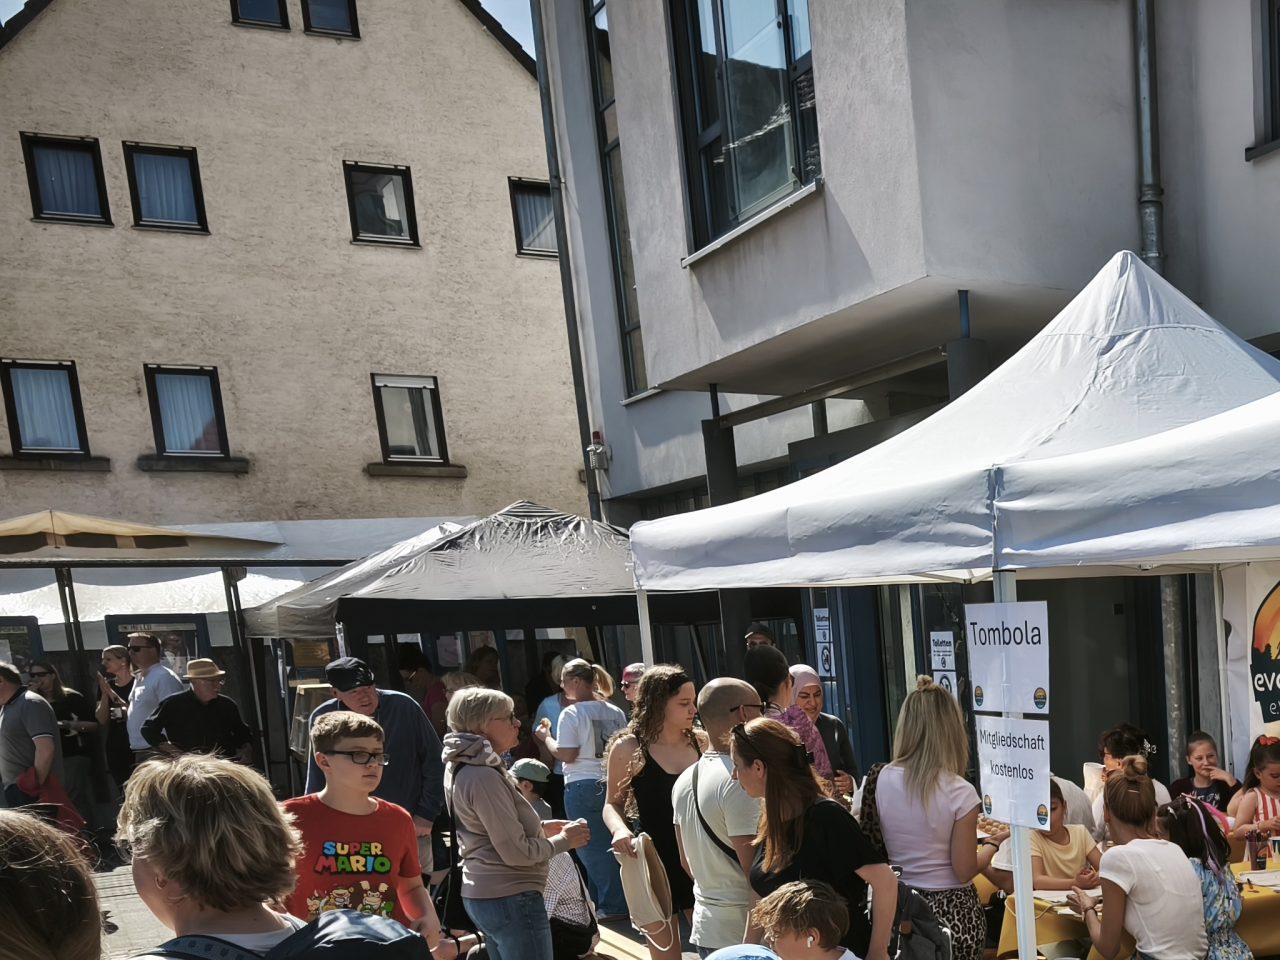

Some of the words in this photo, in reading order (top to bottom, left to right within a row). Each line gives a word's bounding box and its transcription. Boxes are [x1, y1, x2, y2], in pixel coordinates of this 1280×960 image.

[970, 620, 1042, 646] Tombola
[979, 728, 1045, 751] Mitgliedschaft
[989, 759, 1034, 781] kostenlos
[323, 841, 383, 855] SUPER
[314, 855, 392, 875] MARIO
